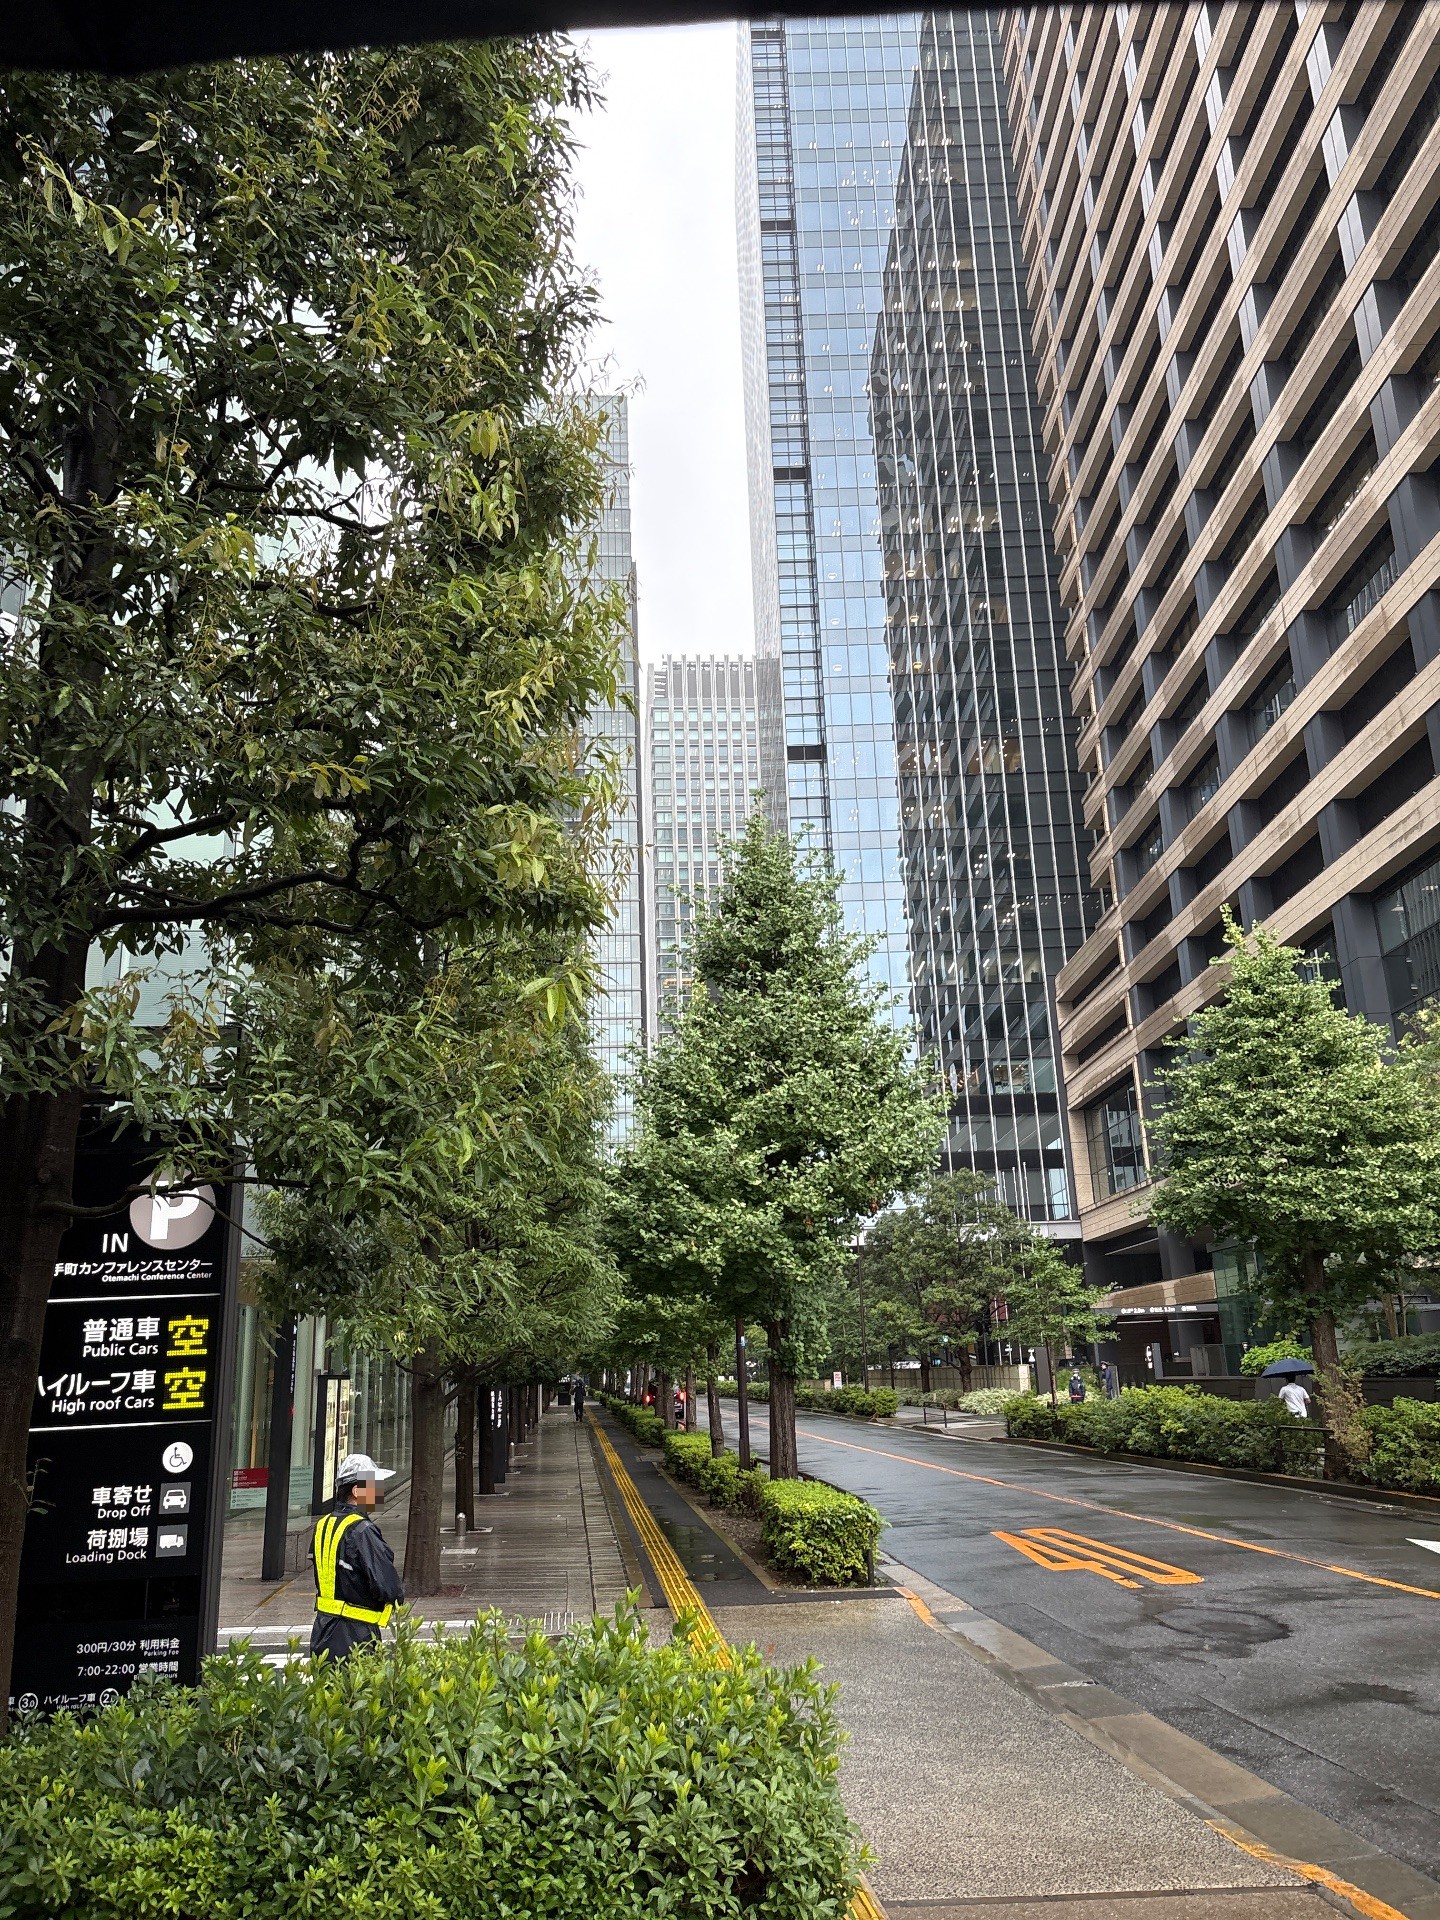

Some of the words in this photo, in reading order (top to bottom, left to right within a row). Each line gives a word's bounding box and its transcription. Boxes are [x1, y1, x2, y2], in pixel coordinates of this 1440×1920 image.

[150, 1181, 200, 1240] P
[102, 1233, 129, 1253] IN
[54, 1259, 213, 1276] 手町カンファレンスセンター
[101, 1273, 140, 1283] Otemachi
[141, 1272, 185, 1281] Conference
[186, 1271, 212, 1280] Center
[82, 1316, 161, 1343] 普通車
[166, 1315, 209, 1357] 空
[83, 1345, 126, 1358] Public
[129, 1344, 159, 1355] Cars
[162, 1366, 207, 1410] 空
[51, 1399, 85, 1416] High
[89, 1398, 122, 1410] roof
[124, 1397, 155, 1408] Cars
[91, 1484, 153, 1507] 車寄せ
[97, 1507, 127, 1520] Drop
[130, 1504, 151, 1517] Off
[86, 1527, 149, 1550] 荷捌場
[65, 1551, 114, 1565] Loading
[117, 1549, 147, 1561] Dock
[990, 1527, 1206, 1590] 40
[76, 1640, 137, 1655] 300円/30分
[139, 1638, 180, 1651] 利用料金
[143, 1650, 167, 1658] Parking
[77, 1663, 136, 1677] 7:00-22:00
[43, 1692, 97, 1705] ハイルーフ車
